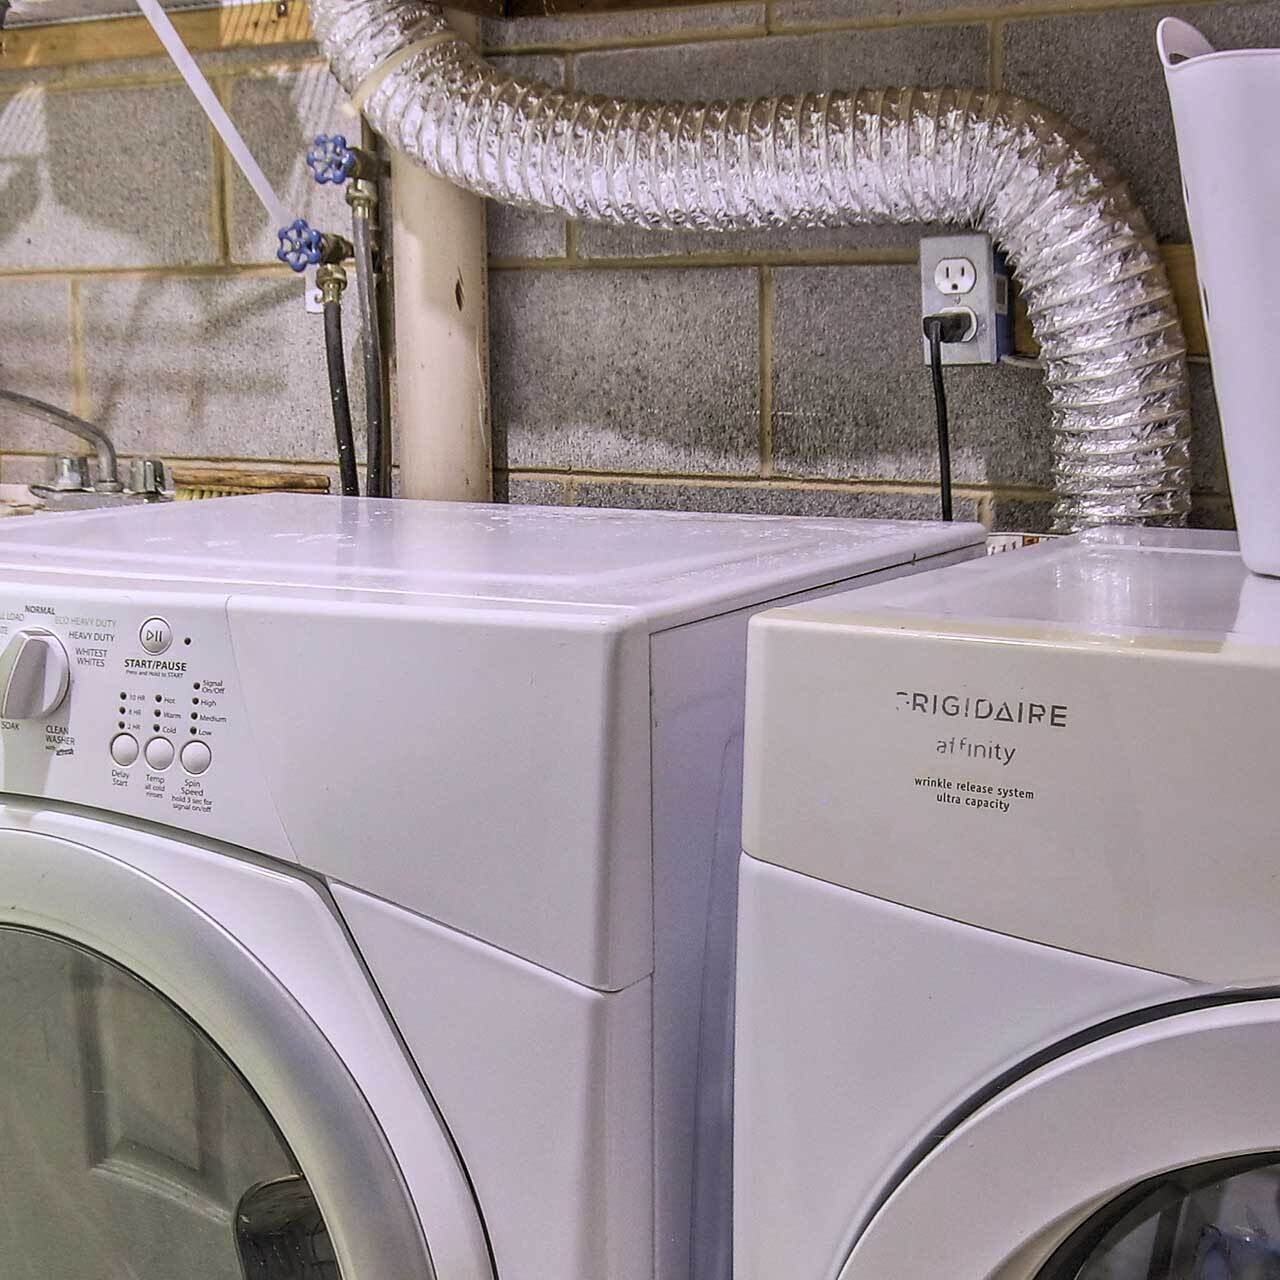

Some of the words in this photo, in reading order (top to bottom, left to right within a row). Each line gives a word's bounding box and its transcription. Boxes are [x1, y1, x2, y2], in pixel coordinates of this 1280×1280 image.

[24, 606, 56, 615] NORMAL
[6, 612, 24, 622] LOAD
[56, 616, 70, 624] ECO
[70, 617, 94, 626] HEAVY
[96, 619, 116, 628] DUTY
[69, 632, 92, 641] HEAVY
[93, 633, 115, 642] DUTY
[75, 648, 108, 658] WHITEST
[77, 658, 105, 667] WHITES
[124, 658, 188, 672] START/PAUSE
[202, 680, 224, 688] Signal
[200, 700, 216, 708] High
[164, 711, 181, 719] Warm
[200, 714, 227, 722] Medium
[1, 721, 20, 730] SOAK
[46, 725, 69, 735] CLEAN
[45, 734, 75, 746] WASHER
[936, 736, 1016, 766] affinity
[112, 770, 129, 779] Delay
[146, 774, 165, 784] Temp
[113, 778, 128, 787] Start
[184, 779, 201, 788] Spin
[180, 787, 204, 796] Speed
[914, 776, 953, 790] wrinkle
[956, 781, 994, 795] release
[997, 786, 1034, 800] system
[173, 803, 191, 811] signal
[936, 794, 961, 805] ultra
[965, 796, 1010, 812] capacity
